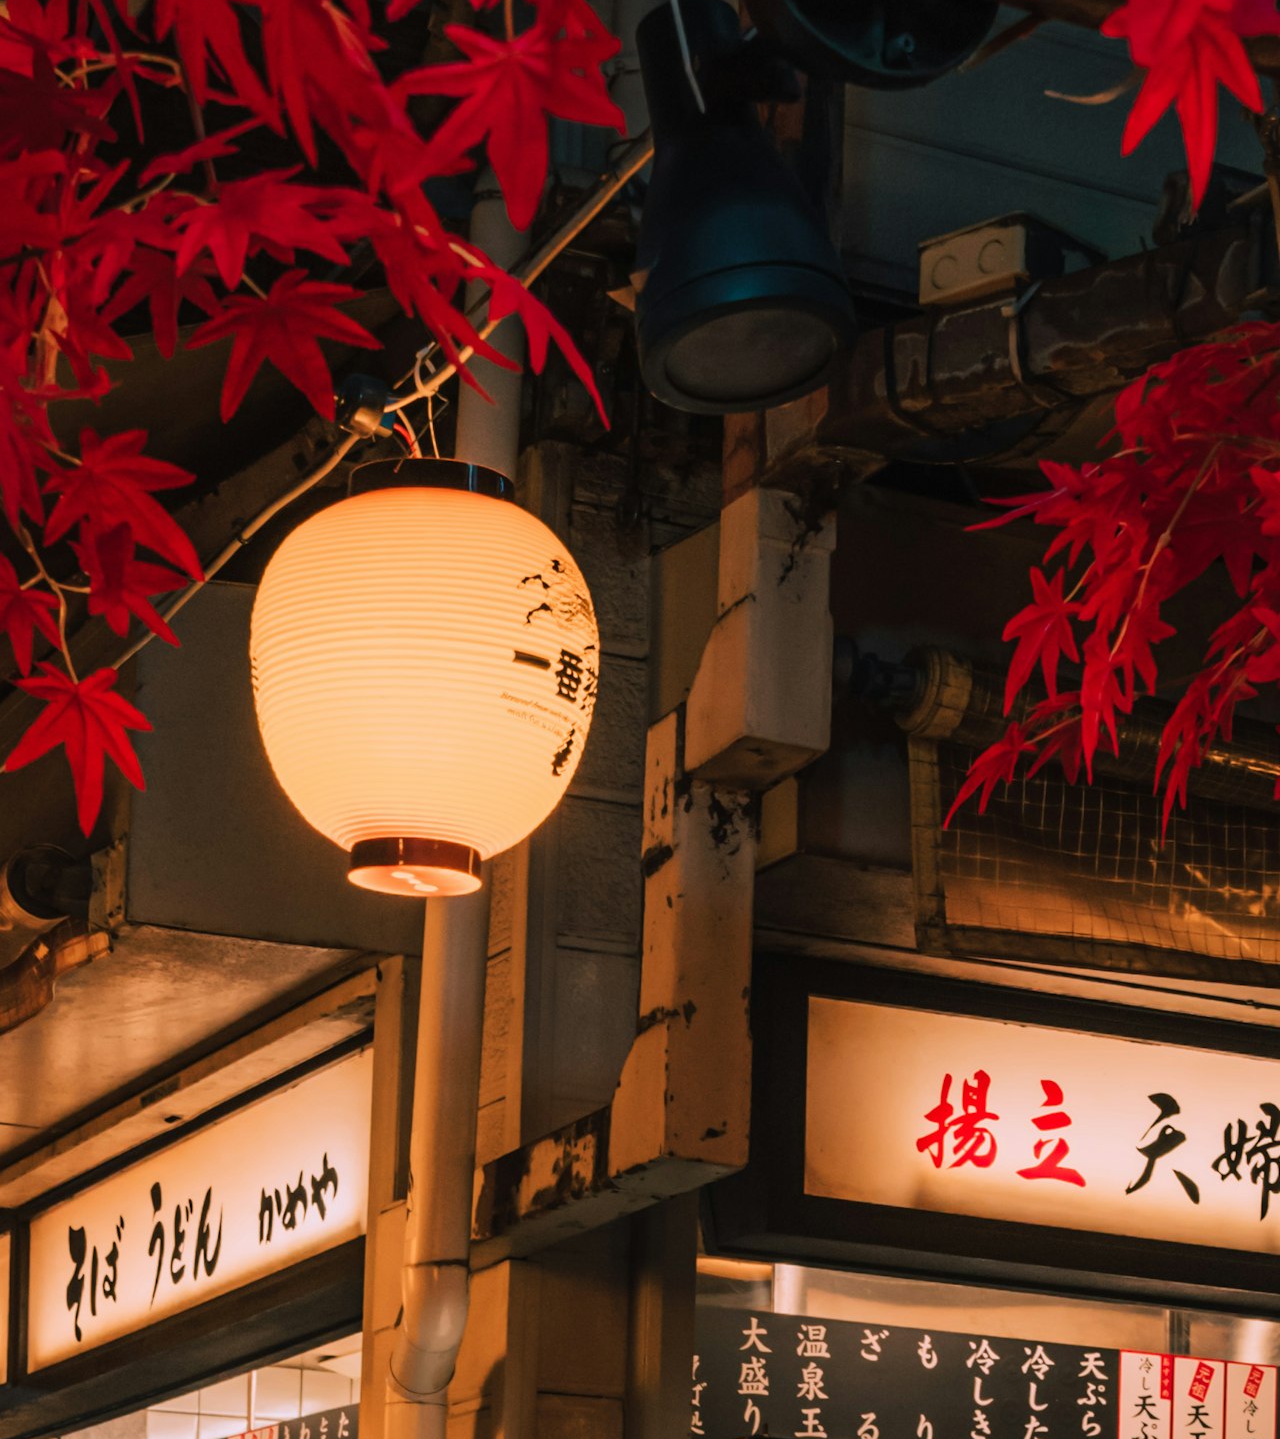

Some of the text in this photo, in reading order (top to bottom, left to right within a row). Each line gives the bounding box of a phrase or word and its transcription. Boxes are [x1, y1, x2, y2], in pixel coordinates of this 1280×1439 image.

[914, 1069, 1089, 1191] 揚立
[66, 1151, 340, 1343] そば うどん かめや
[737, 1316, 773, 1436] 大盛り
[794, 1323, 832, 1439] 温泉玉
[1192, 1365, 1211, 1401] 元祖
